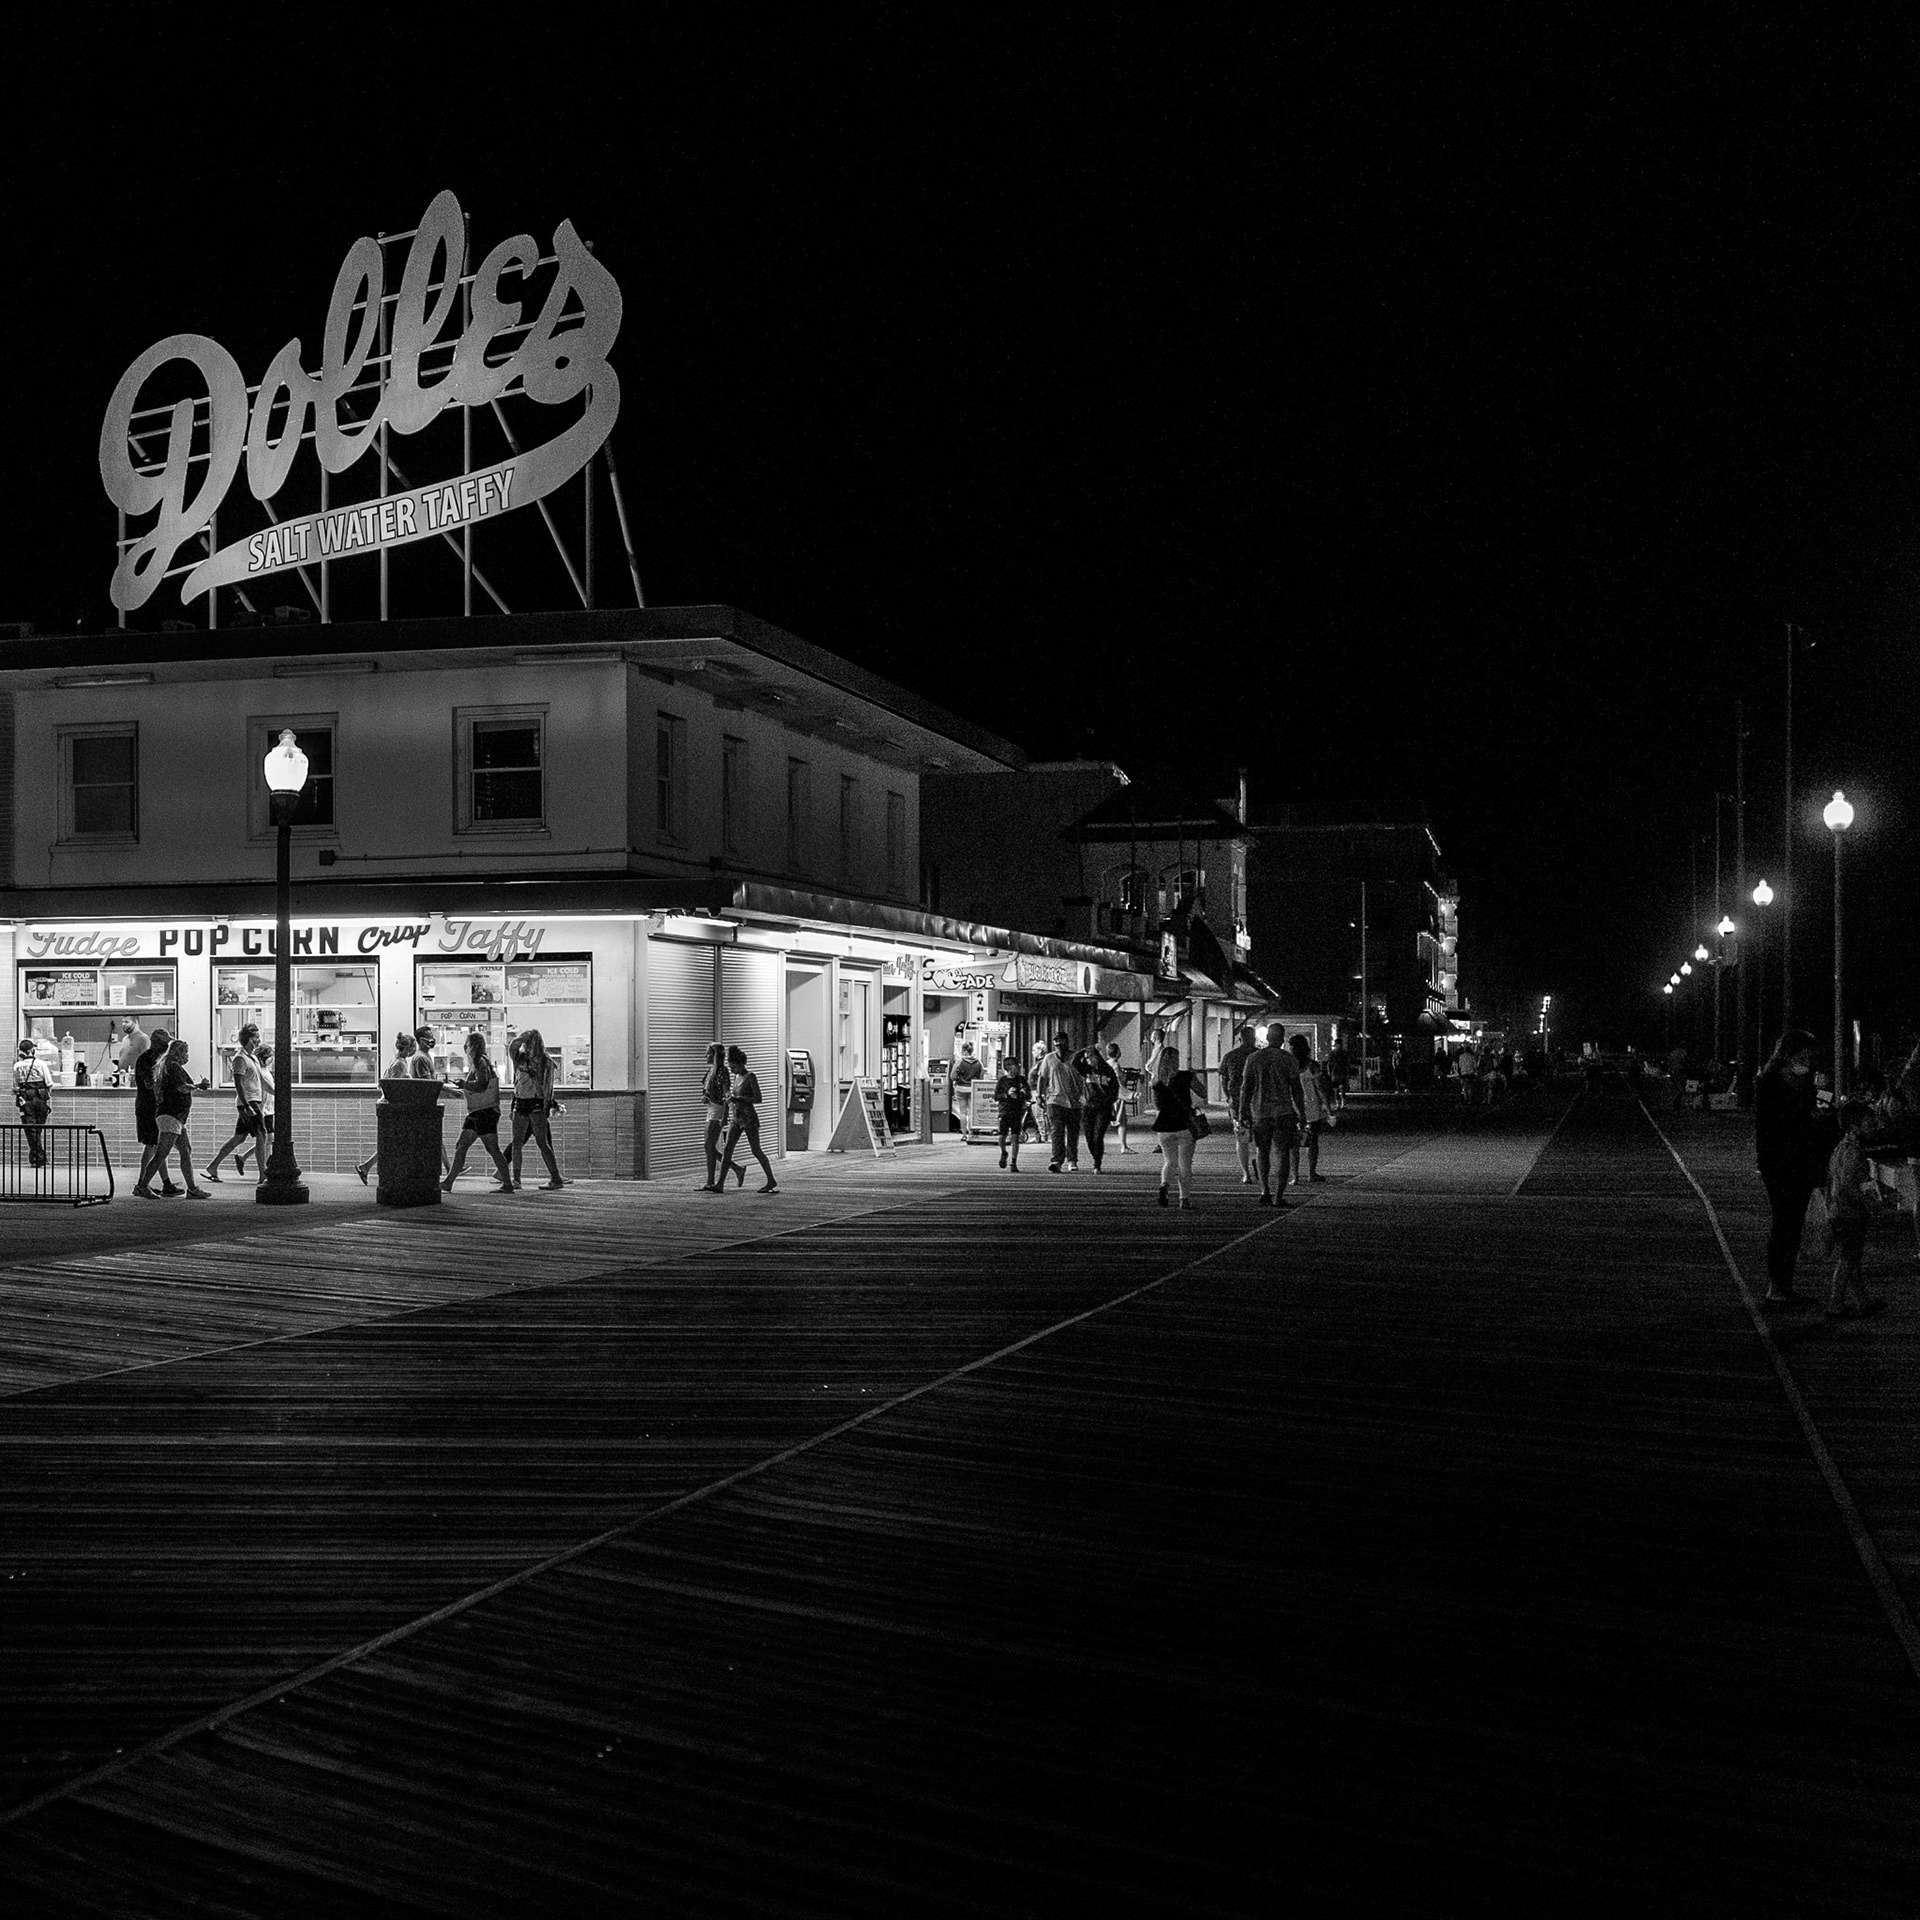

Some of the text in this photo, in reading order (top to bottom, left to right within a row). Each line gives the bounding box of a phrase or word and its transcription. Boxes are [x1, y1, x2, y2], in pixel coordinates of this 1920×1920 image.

[249, 469, 514, 572] SALT WATER TAFFY
[27, 931, 140, 967] Fudge
[160, 924, 229, 956] POP
[358, 924, 431, 954] Crisp
[439, 921, 545, 962] Taffy
[459, 1011, 476, 1019] CORN
